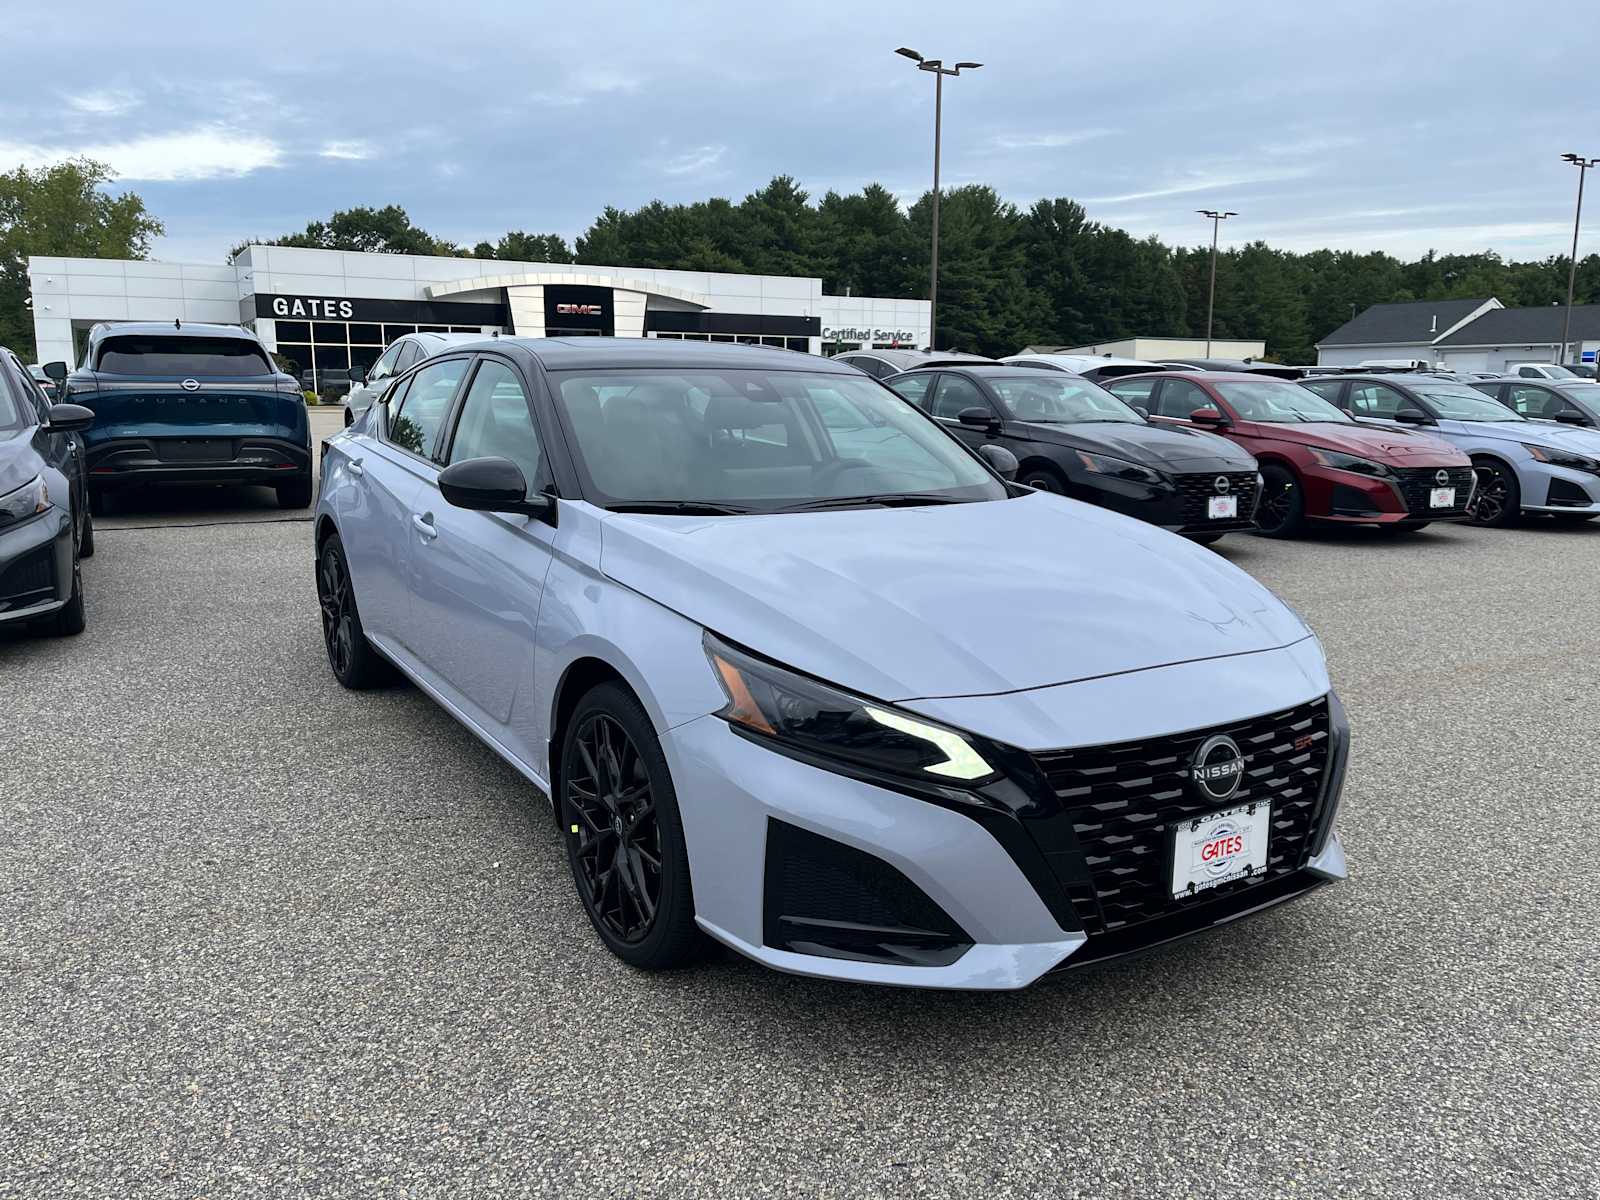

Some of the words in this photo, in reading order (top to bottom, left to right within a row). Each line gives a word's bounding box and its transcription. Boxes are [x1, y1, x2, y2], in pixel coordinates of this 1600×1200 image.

[273, 297, 353, 318] GATES
[557, 303, 602, 315] GMC
[822, 327, 871, 341] Certified
[873, 329, 913, 342] Service
[1194, 758, 1244, 779] NISSAN
[1201, 835, 1243, 862] GATES
